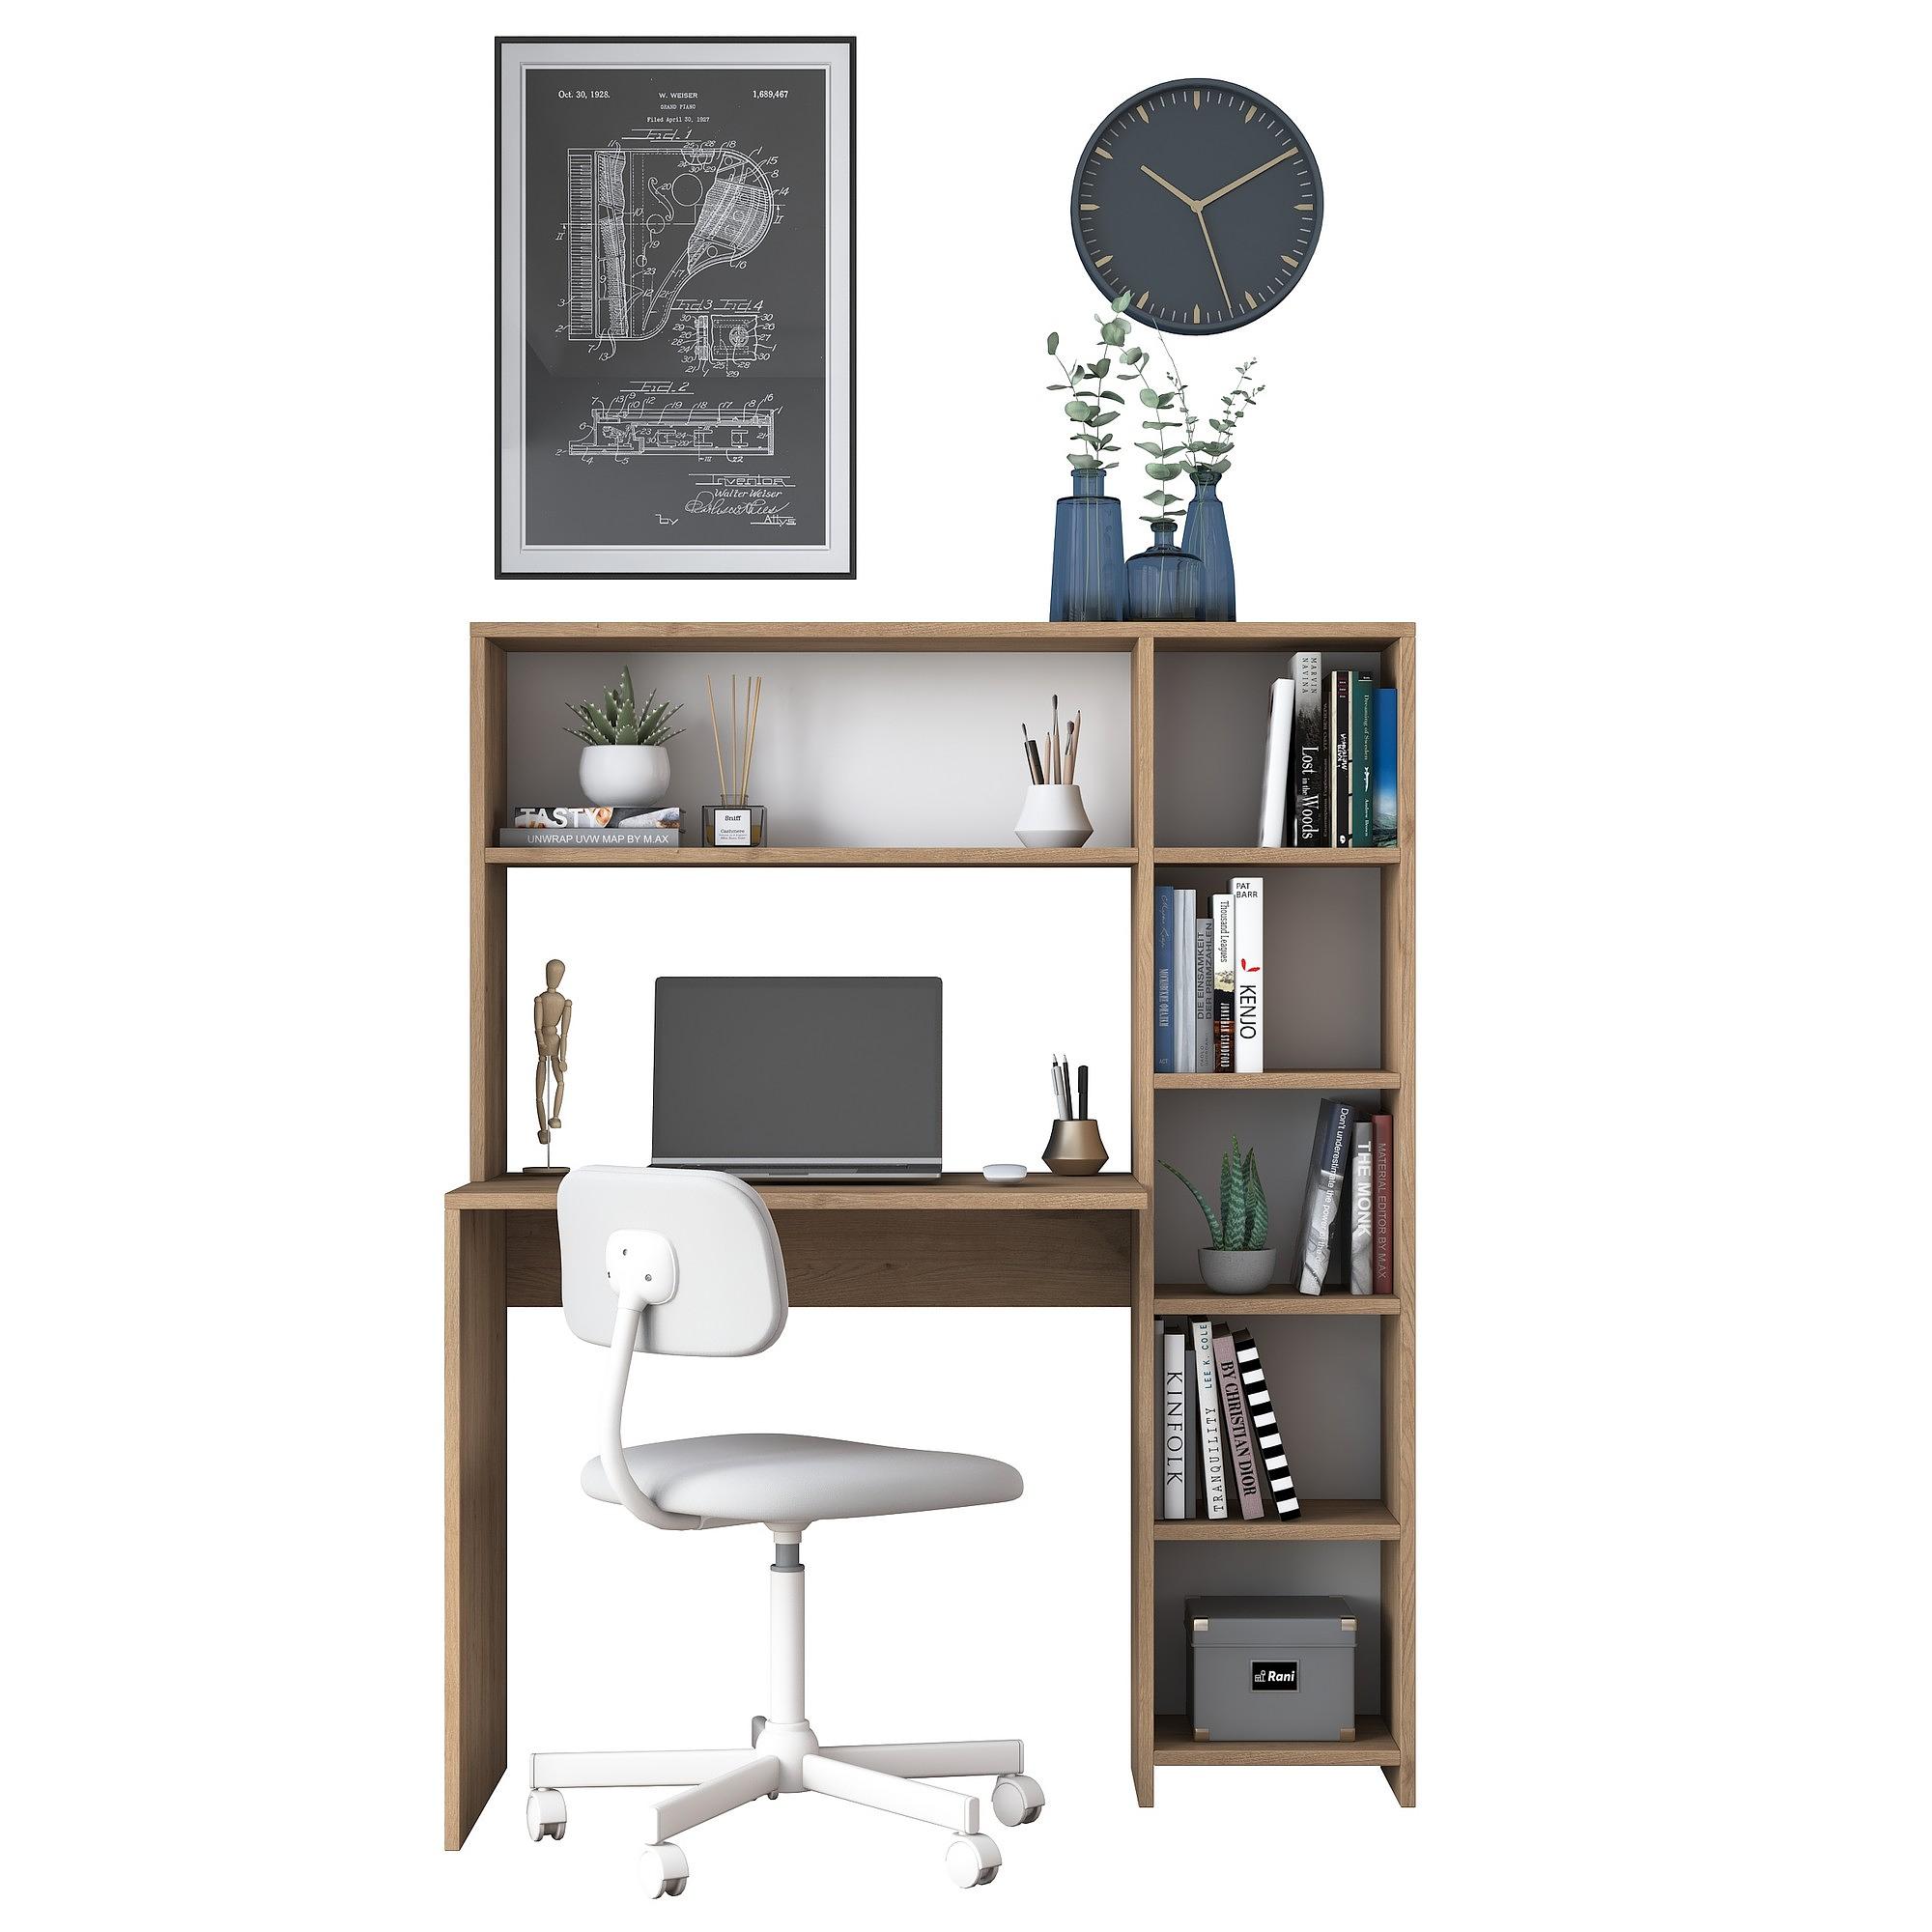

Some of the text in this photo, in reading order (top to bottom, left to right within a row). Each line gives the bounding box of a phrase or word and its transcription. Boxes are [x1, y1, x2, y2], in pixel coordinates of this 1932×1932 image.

[558, 90, 611, 99] Oct. 30, 1928.
[753, 90, 788, 99] 1,689,467
[715, 489, 782, 497] Walter Weiser
[655, 514, 678, 526] by
[1302, 746, 1319, 775] Lost
[521, 808, 600, 828] TASTY
[1302, 794, 1320, 838] Woods
[527, 835, 668, 843] UNWRAP UVW MAP BY M.AX
[1219, 900, 1229, 962] Thousand Leagues
[1221, 1003, 1230, 1032] JONATHAN
[1239, 985, 1256, 1039] KENJO
[1338, 1108, 1349, 1129] Don't
[1328, 1130, 1343, 1188] underestimate
[1378, 1144, 1386, 1193] MATERIAL
[1325, 1190, 1335, 1203] the
[1358, 1141, 1372, 1236] THE MONK
[1321, 1205, 1330, 1231] power
[1378, 1195, 1387, 1235] EDITOR
[1378, 1237, 1386, 1250] BY
[1167, 1372, 1182, 1486] KINFOLK
[1200, 1324, 1224, 1512] TRANQUILITY LEE K. COLE
[1220, 1360, 1256, 1496] BY CHRISTIAN DIOR
[1267, 1670, 1295, 1682] Rani
